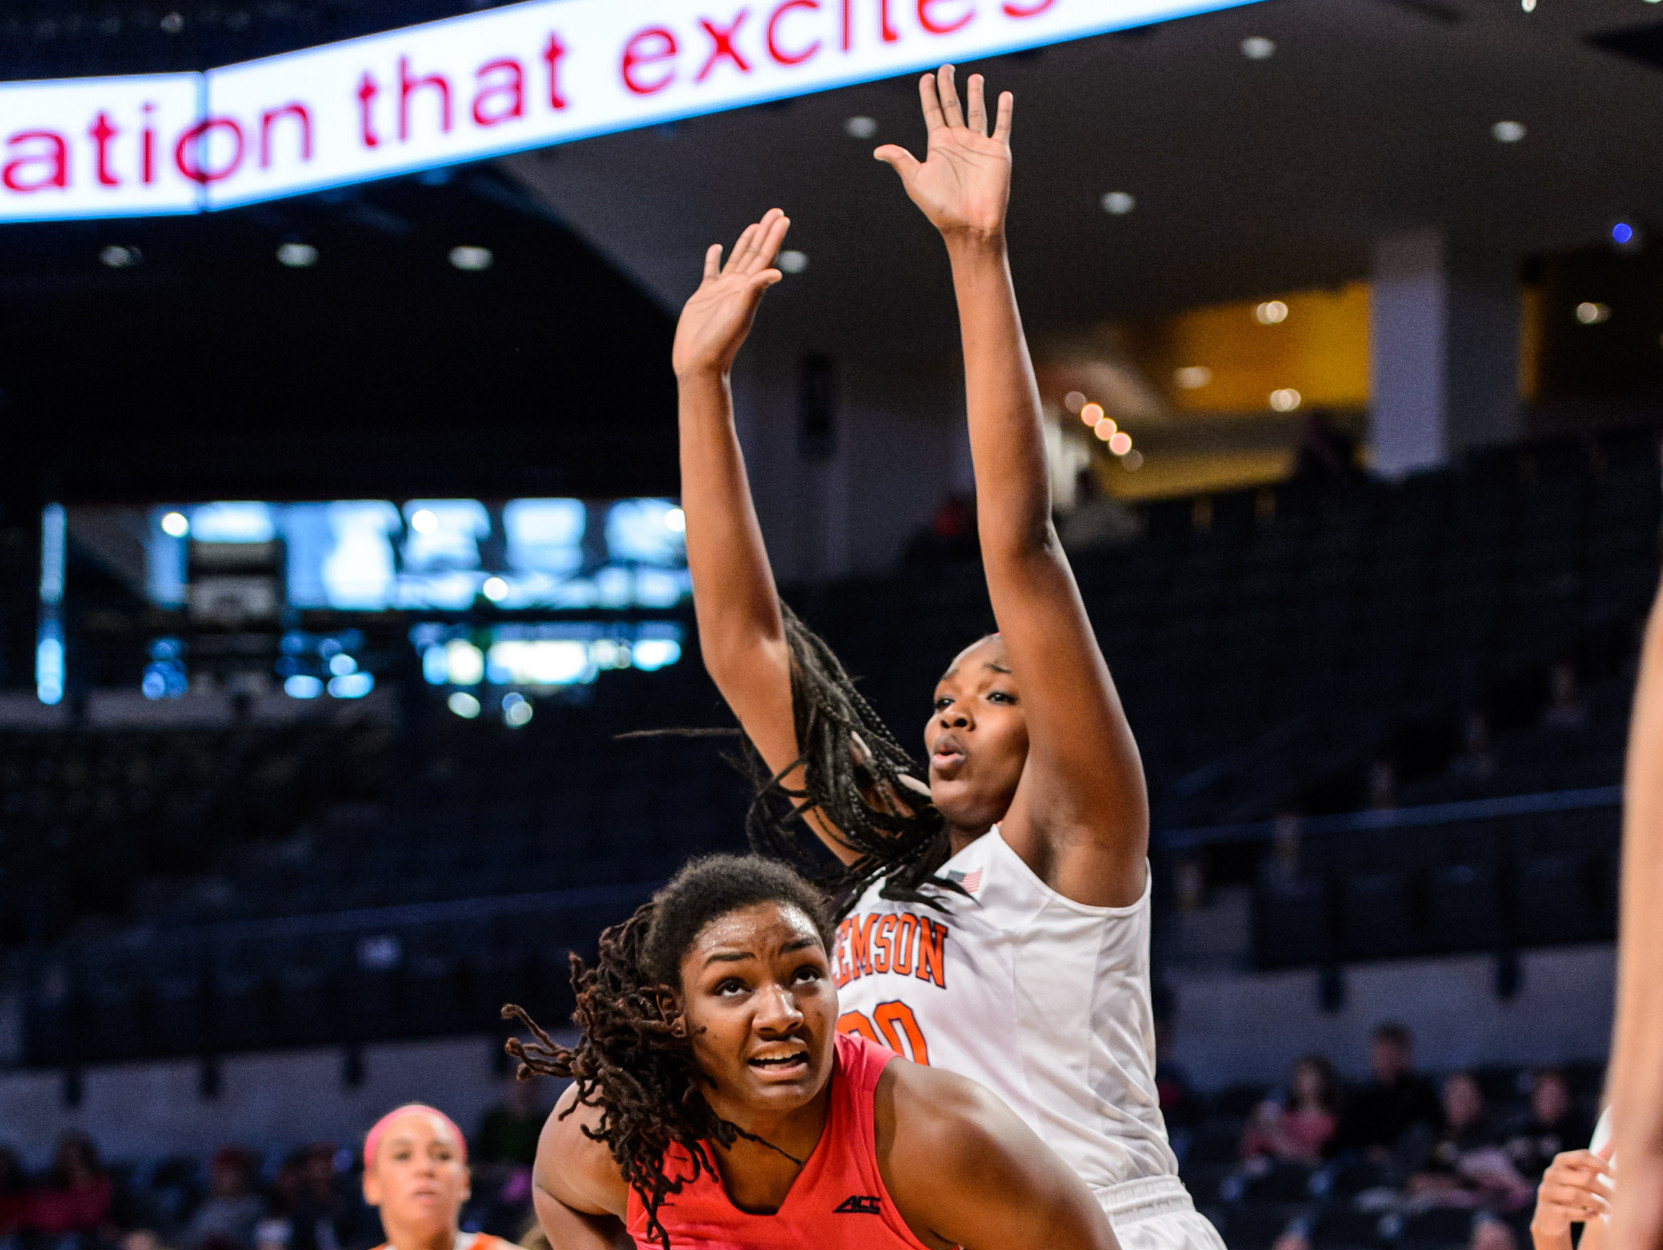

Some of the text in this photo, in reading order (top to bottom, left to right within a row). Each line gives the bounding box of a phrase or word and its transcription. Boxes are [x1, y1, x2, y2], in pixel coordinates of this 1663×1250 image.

[1, 103, 312, 192] ation
[357, 32, 566, 148] that
[832, 912, 949, 989] EMSON
[833, 1195, 881, 1214] ACC
